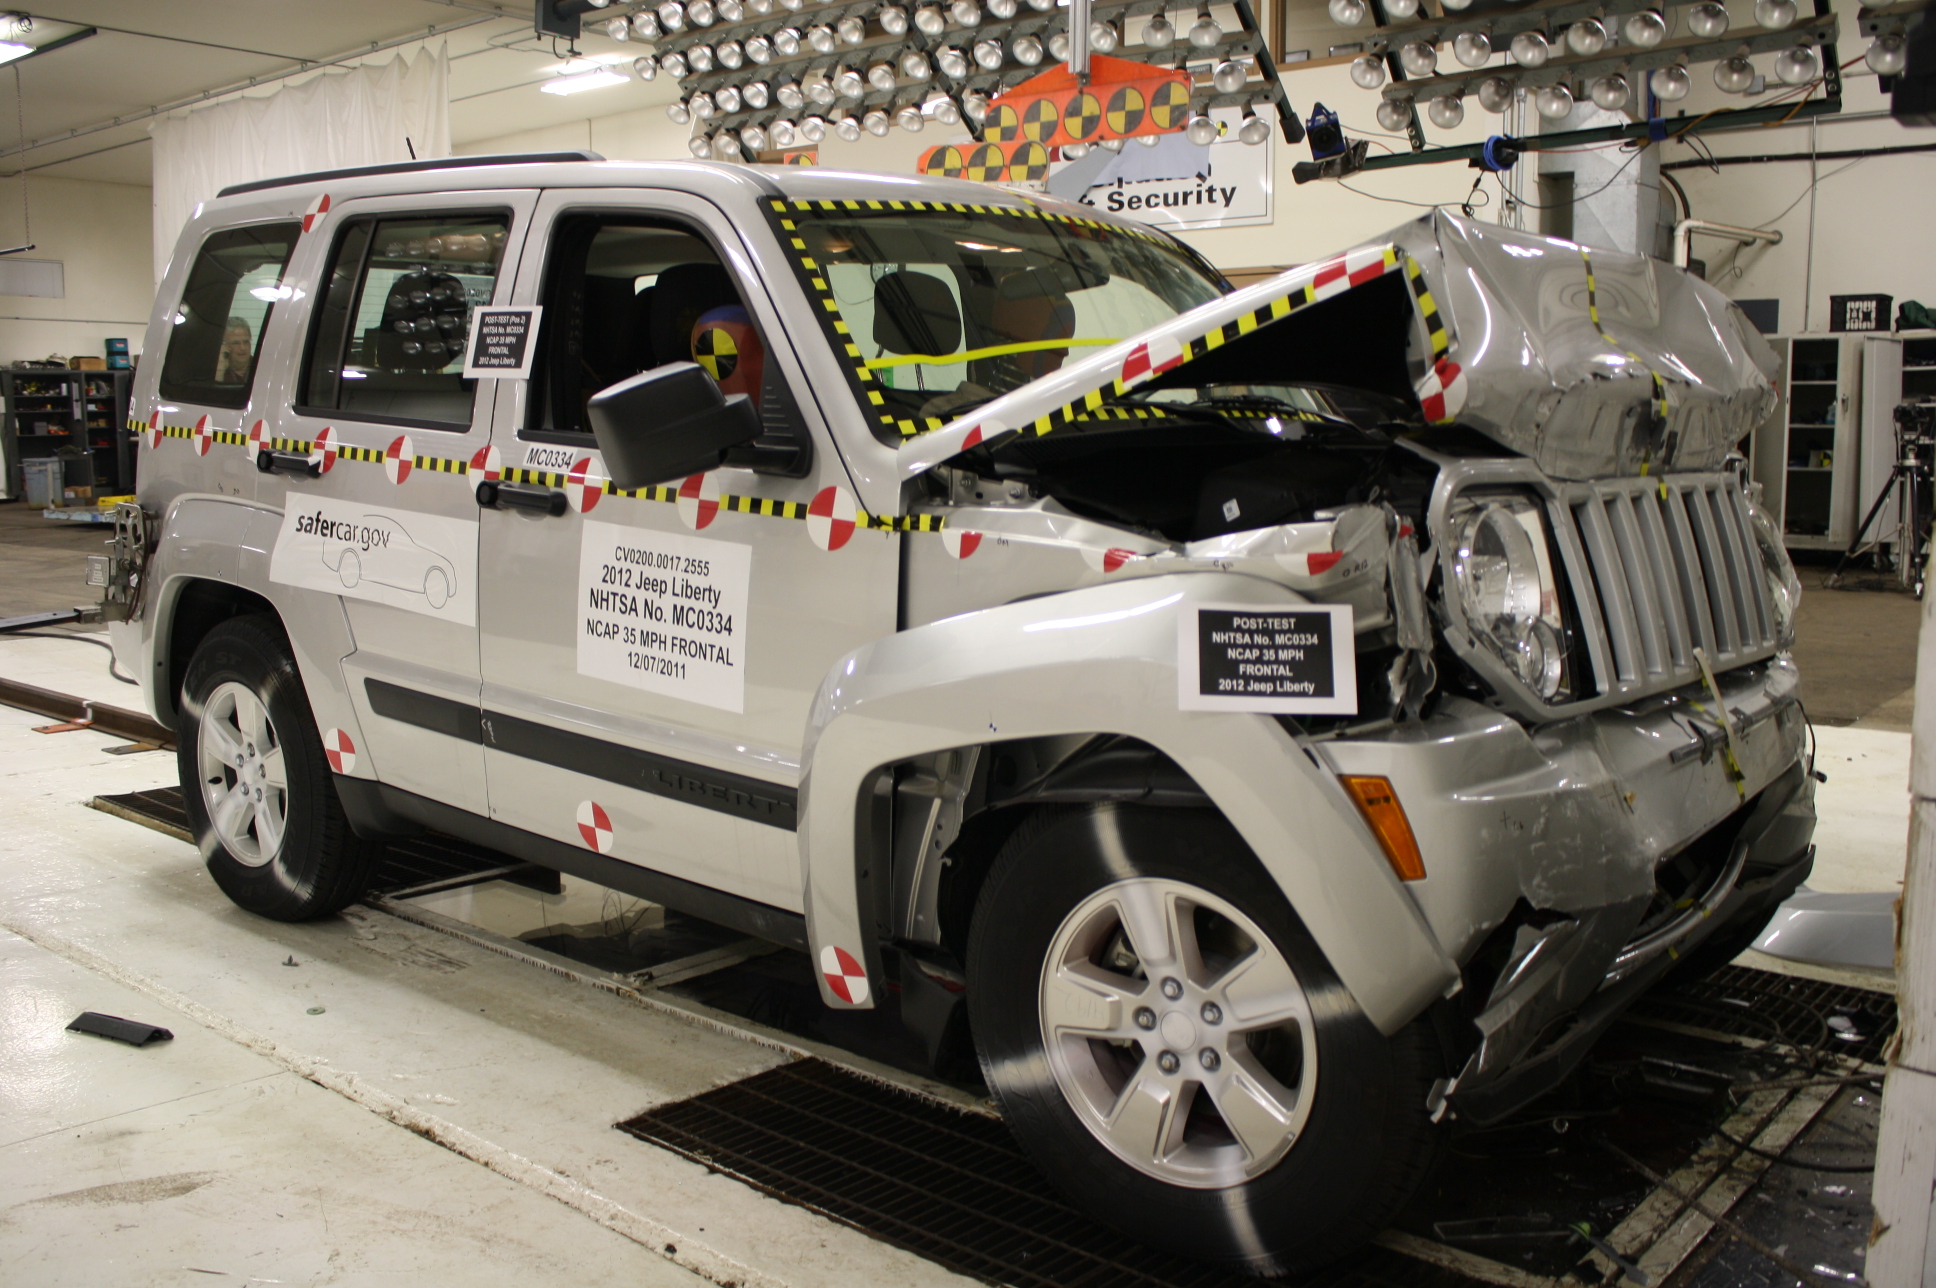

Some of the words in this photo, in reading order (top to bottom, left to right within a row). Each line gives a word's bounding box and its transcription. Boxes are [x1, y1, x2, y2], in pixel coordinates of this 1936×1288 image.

[1107, 184, 1237, 212] Security
[485, 315, 509, 324] POST-TEST
[483, 326, 498, 334] NHTSA
[486, 336, 499, 344] NCAP
[505, 336, 516, 344] MPH
[488, 346, 509, 355] FRONTAL
[479, 356, 489, 365] 2012
[489, 356, 499, 366] Jeep
[500, 356, 516, 367] Liberty
[526, 447, 574, 469] MC0334
[295, 510, 391, 551] safercar.gov
[615, 546, 710, 577] CV0200.0017.2555
[602, 564, 632, 588] 2012
[635, 571, 668, 599] Jeep
[672, 576, 722, 609] Liberty
[589, 587, 639, 618] NHTSA
[643, 598, 667, 623] No.
[672, 604, 733, 636] MC0334
[1233, 616, 1296, 630] POST-TEST
[586, 618, 620, 640] NCAP
[623, 626, 636, 645] 35
[640, 629, 667, 652] MPH
[671, 636, 734, 667] FRONTAL
[1212, 631, 1251, 645] NHTSA
[1254, 633, 1272, 645] No.
[1275, 633, 1318, 646] MC0334
[1227, 648, 1260, 660] NCAP
[1262, 649, 1275, 661] 35
[1278, 649, 1304, 661] MPH
[628, 651, 686, 680] 12/07/2011
[1239, 663, 1293, 677] FRONTAL
[1218, 679, 1244, 691] 2012
[1247, 680, 1273, 694] Jeep
[1276, 680, 1315, 695] Liberty
